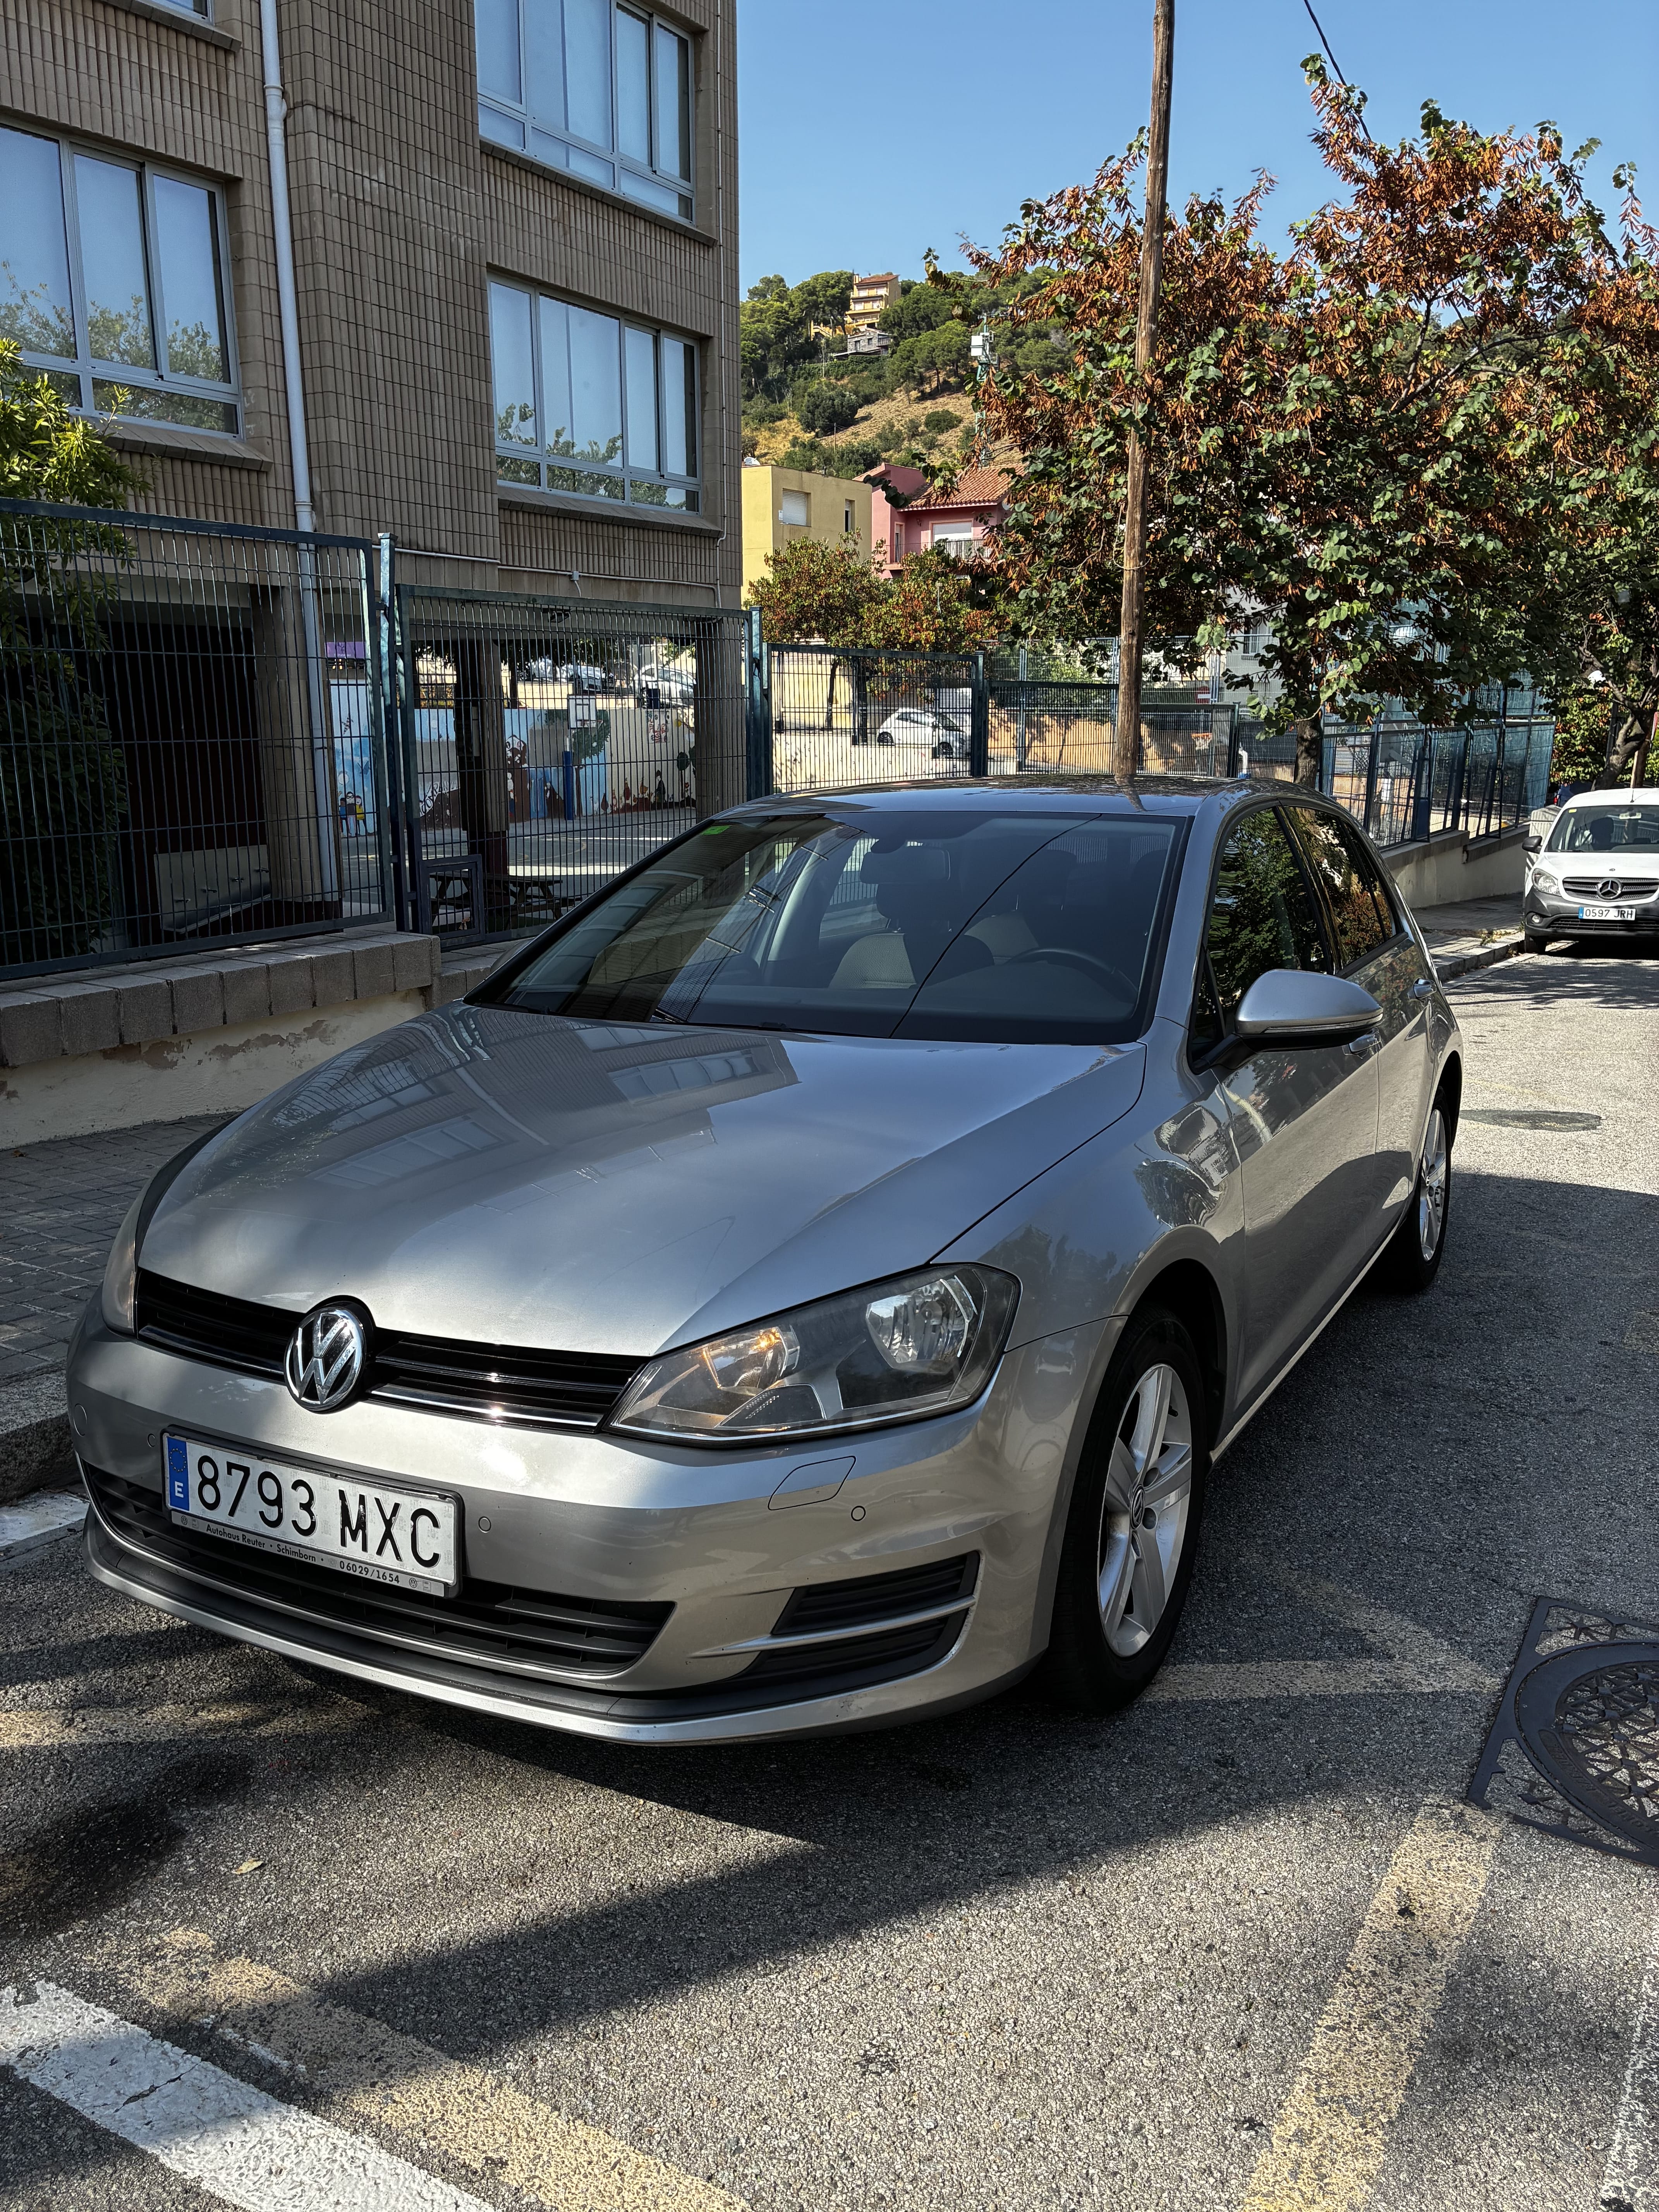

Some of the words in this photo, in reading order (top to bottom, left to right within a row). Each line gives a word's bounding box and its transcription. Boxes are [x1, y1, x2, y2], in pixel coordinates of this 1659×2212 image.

[1585, 909, 1610, 917] 0597
[1614, 910, 1633, 918] JRH
[174, 1481, 184, 1498] E
[197, 1455, 317, 1537] 8793
[338, 1489, 441, 1568] MXC
[206, 1524, 240, 1540] Autohaus
[242, 1534, 265, 1548] Reuter
[276, 1544, 316, 1562] Schimborn
